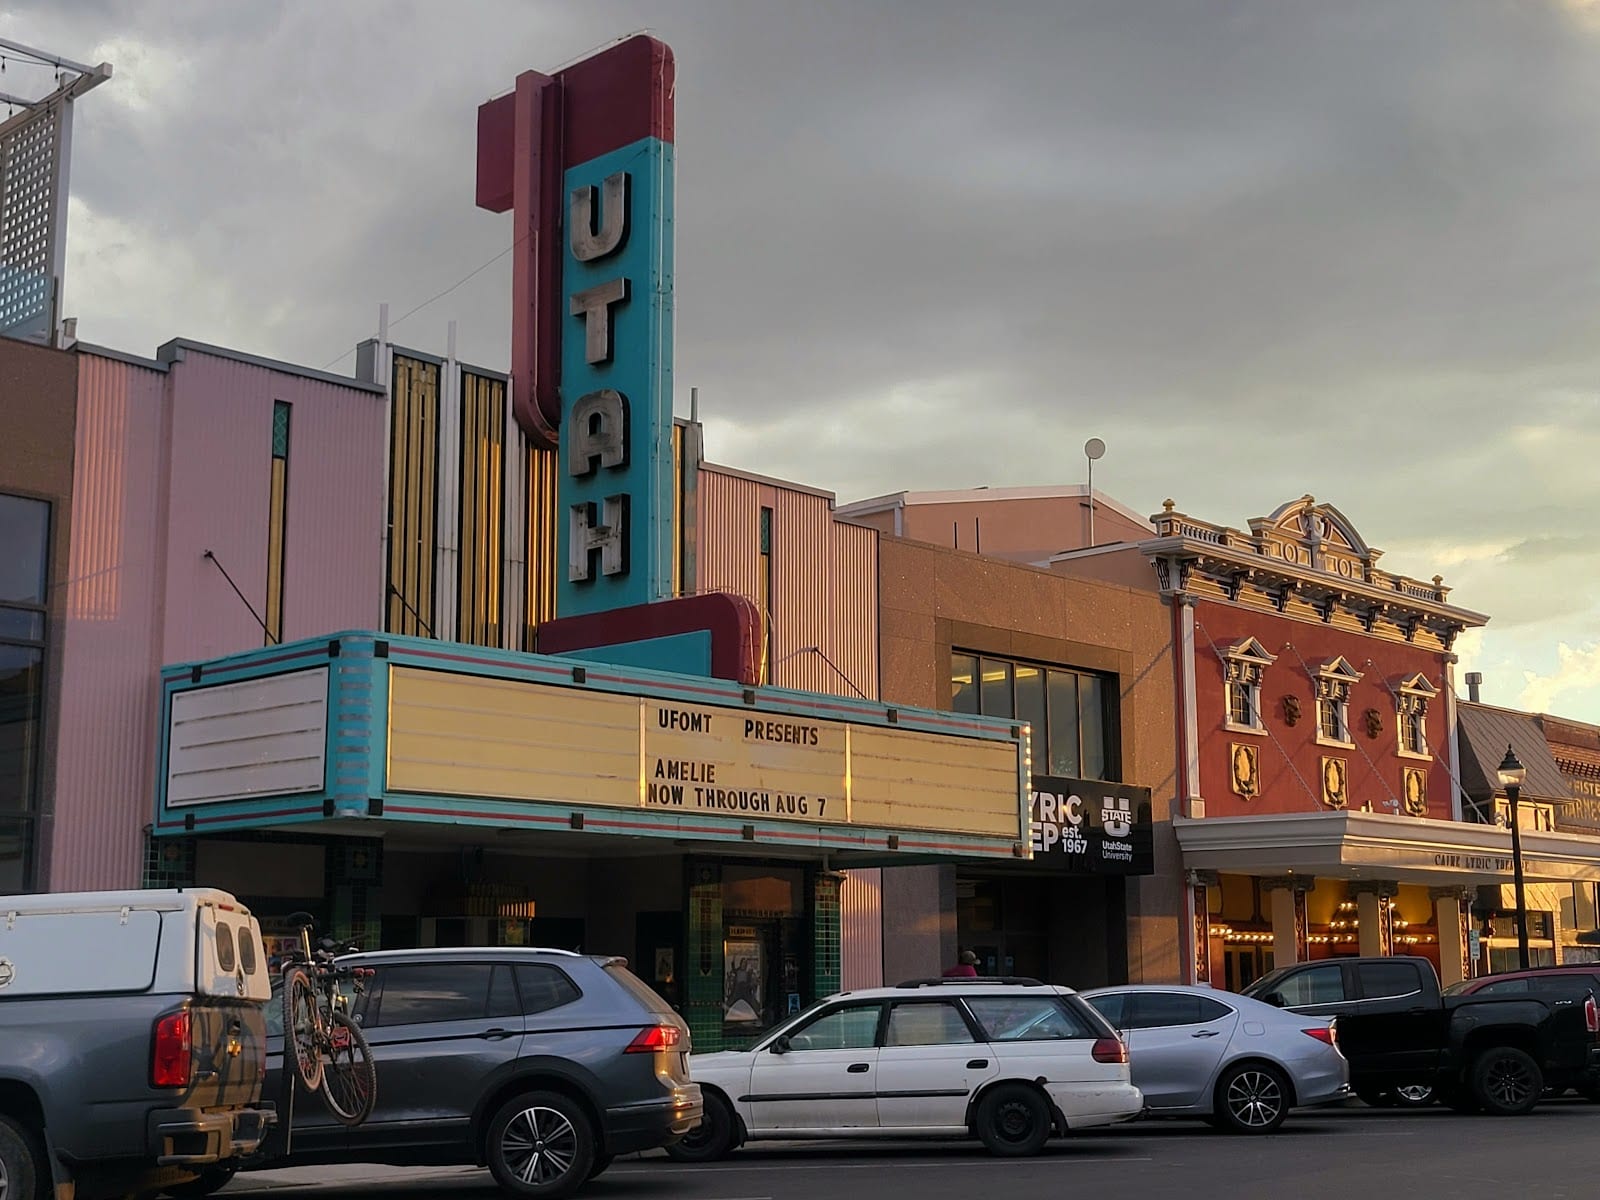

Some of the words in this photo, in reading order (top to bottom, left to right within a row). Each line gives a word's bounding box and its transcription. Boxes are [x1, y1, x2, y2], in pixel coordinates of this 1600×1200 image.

[569, 171, 631, 584] UTAH
[658, 708, 712, 733] UFOMT
[744, 719, 818, 746] PRESENTS
[655, 758, 715, 783] AMELIE
[648, 783, 684, 805] NOW
[694, 787, 769, 812] THROUGH
[776, 795, 808, 814] AUG
[817, 798, 826, 816] 7
[1101, 808, 1132, 824] STATE
[1062, 825, 1082, 839] est.
[1061, 838, 1088, 854] 1967
[1102, 849, 1132, 862] University
